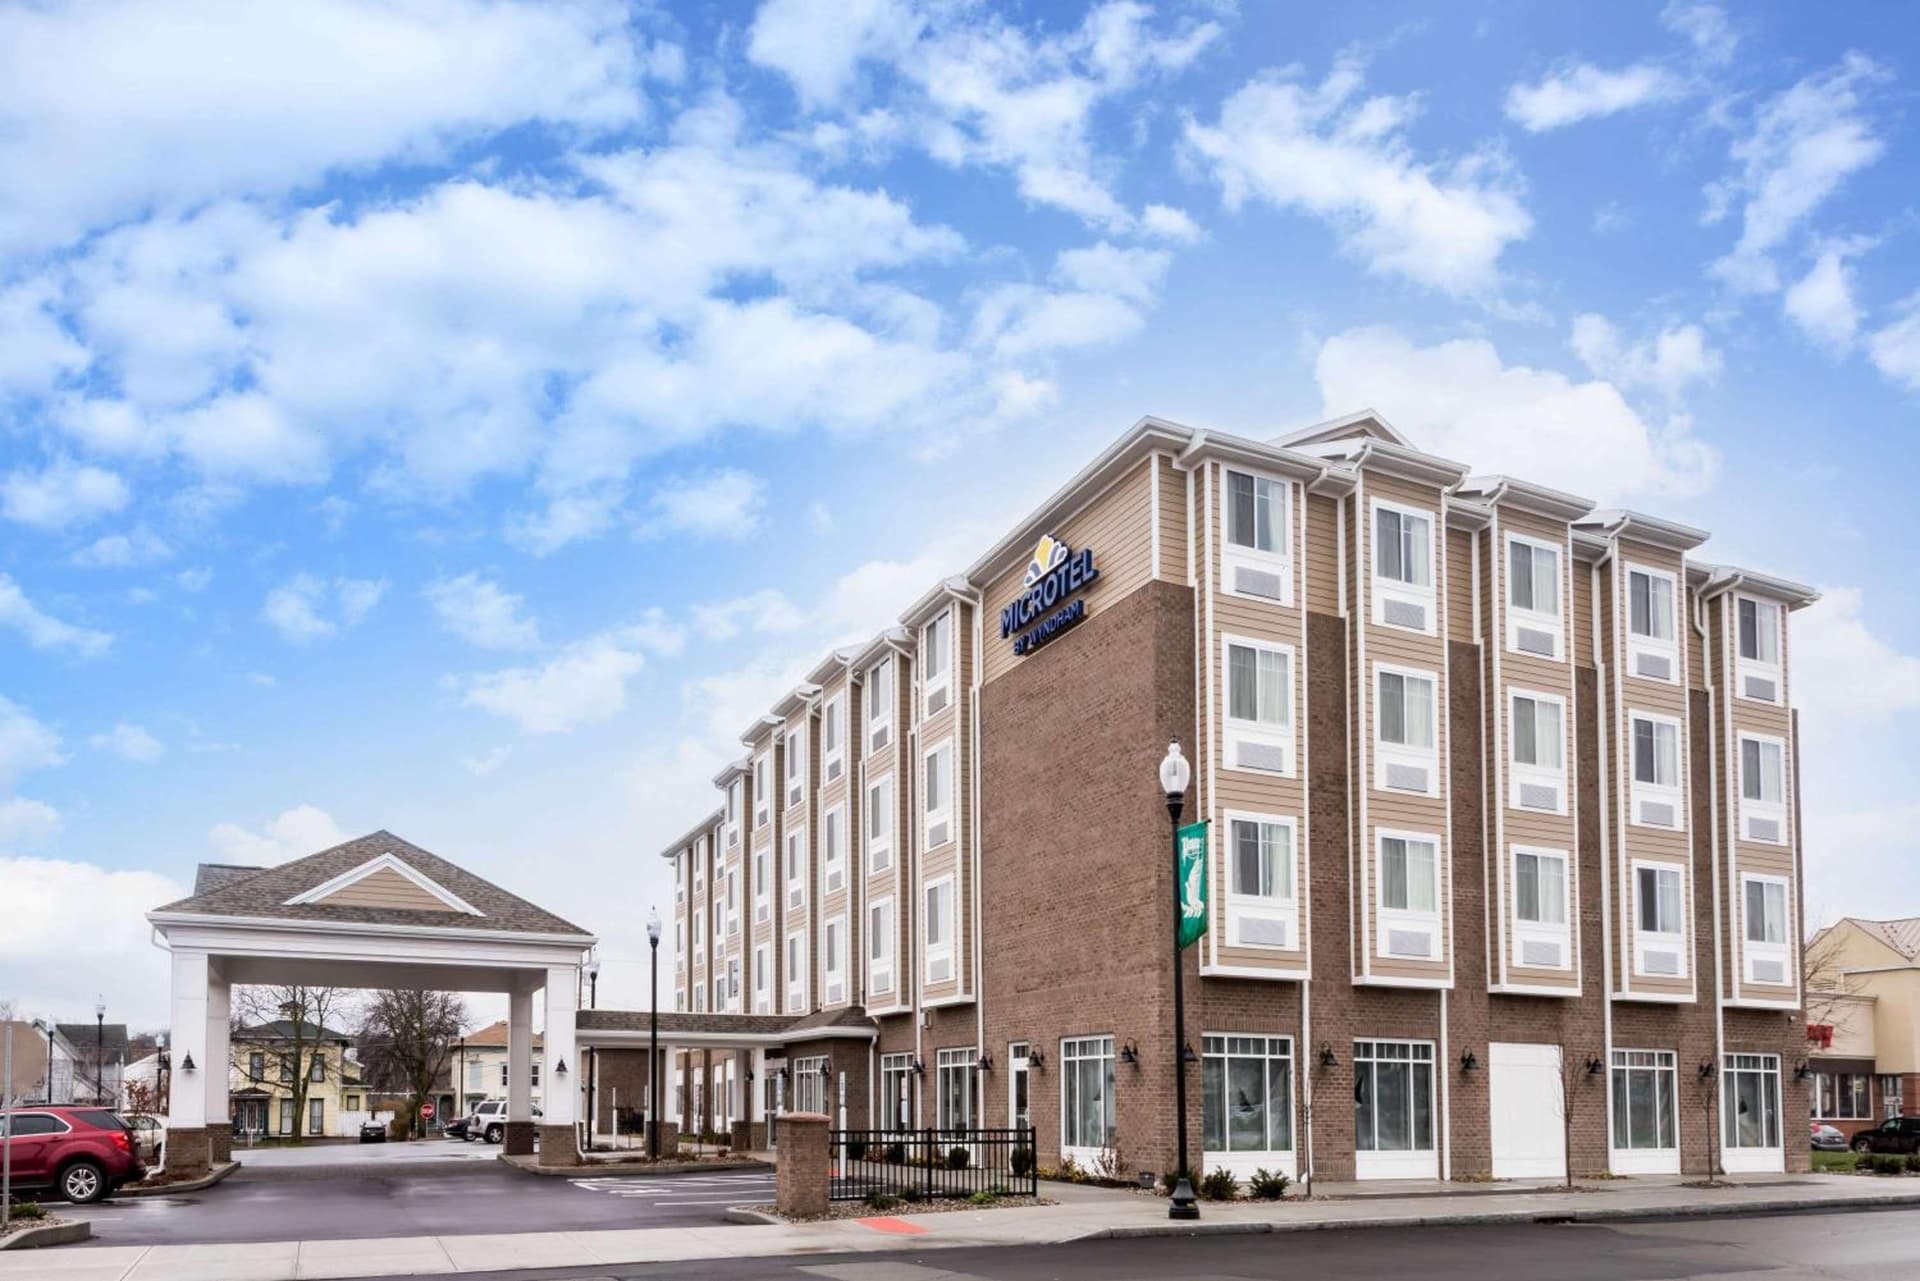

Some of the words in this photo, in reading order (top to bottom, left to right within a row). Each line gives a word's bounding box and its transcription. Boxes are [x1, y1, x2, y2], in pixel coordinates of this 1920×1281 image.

[1001, 548, 1098, 638] MICROTEL
[1014, 635, 1030, 655] BY
[1028, 599, 1084, 645] WYNDHAM
